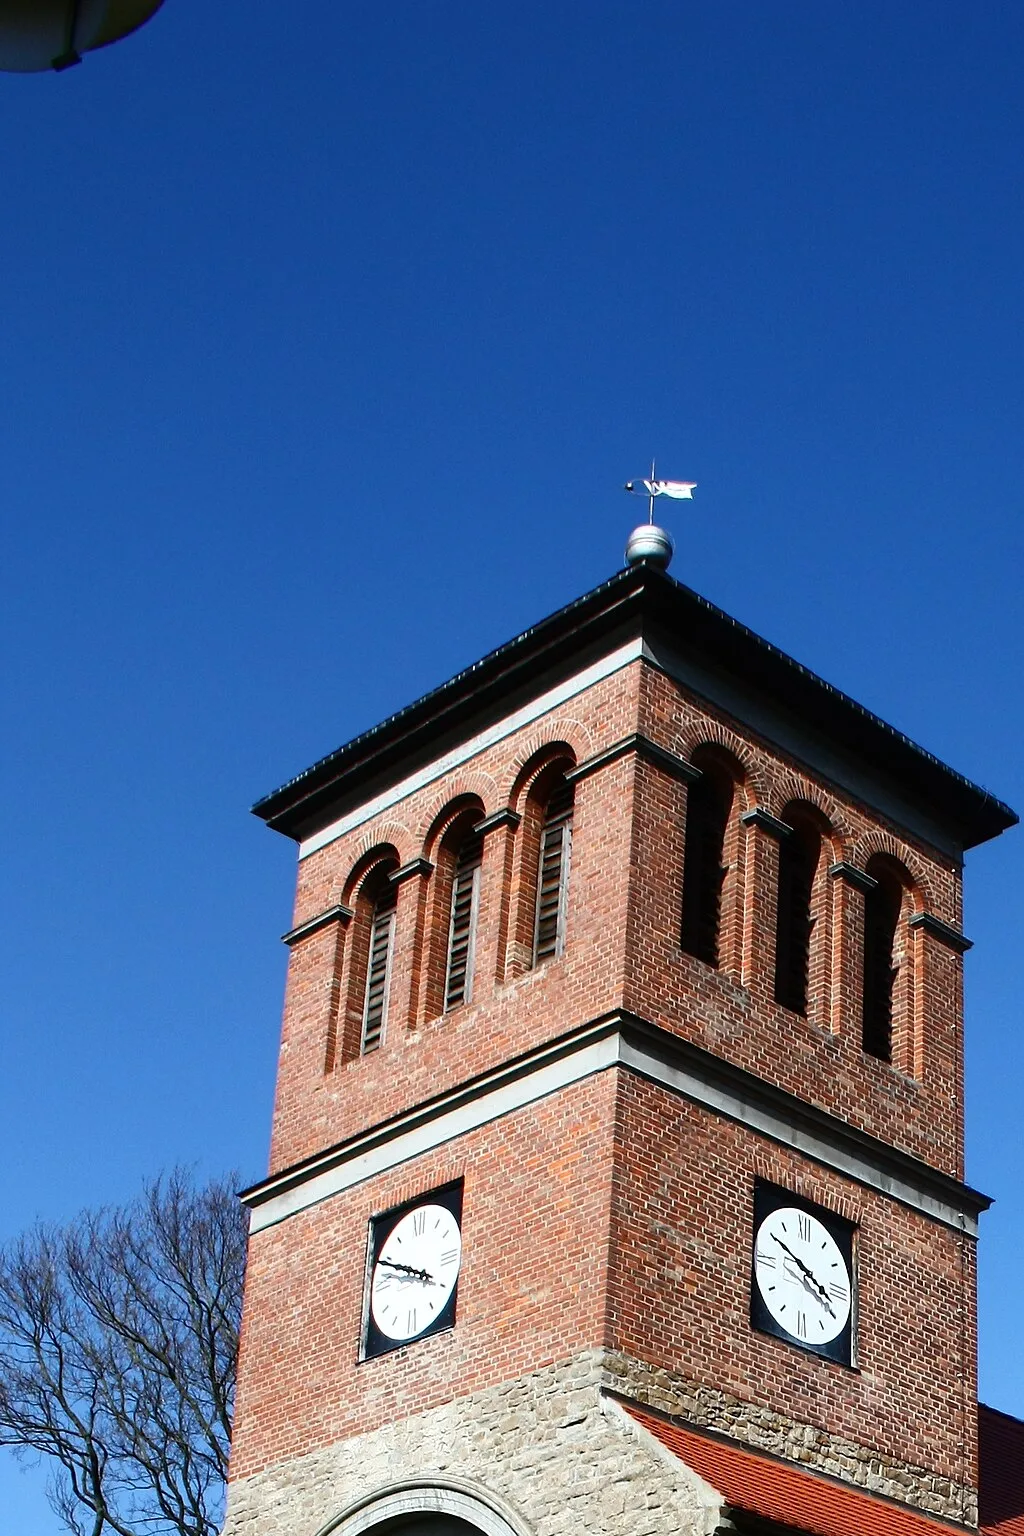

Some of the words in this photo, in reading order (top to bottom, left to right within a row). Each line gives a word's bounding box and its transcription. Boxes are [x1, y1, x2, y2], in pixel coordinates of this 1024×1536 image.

[798, 1214, 811, 1243] XII
[440, 1248, 458, 1267] III
[829, 1282, 848, 1301] III
